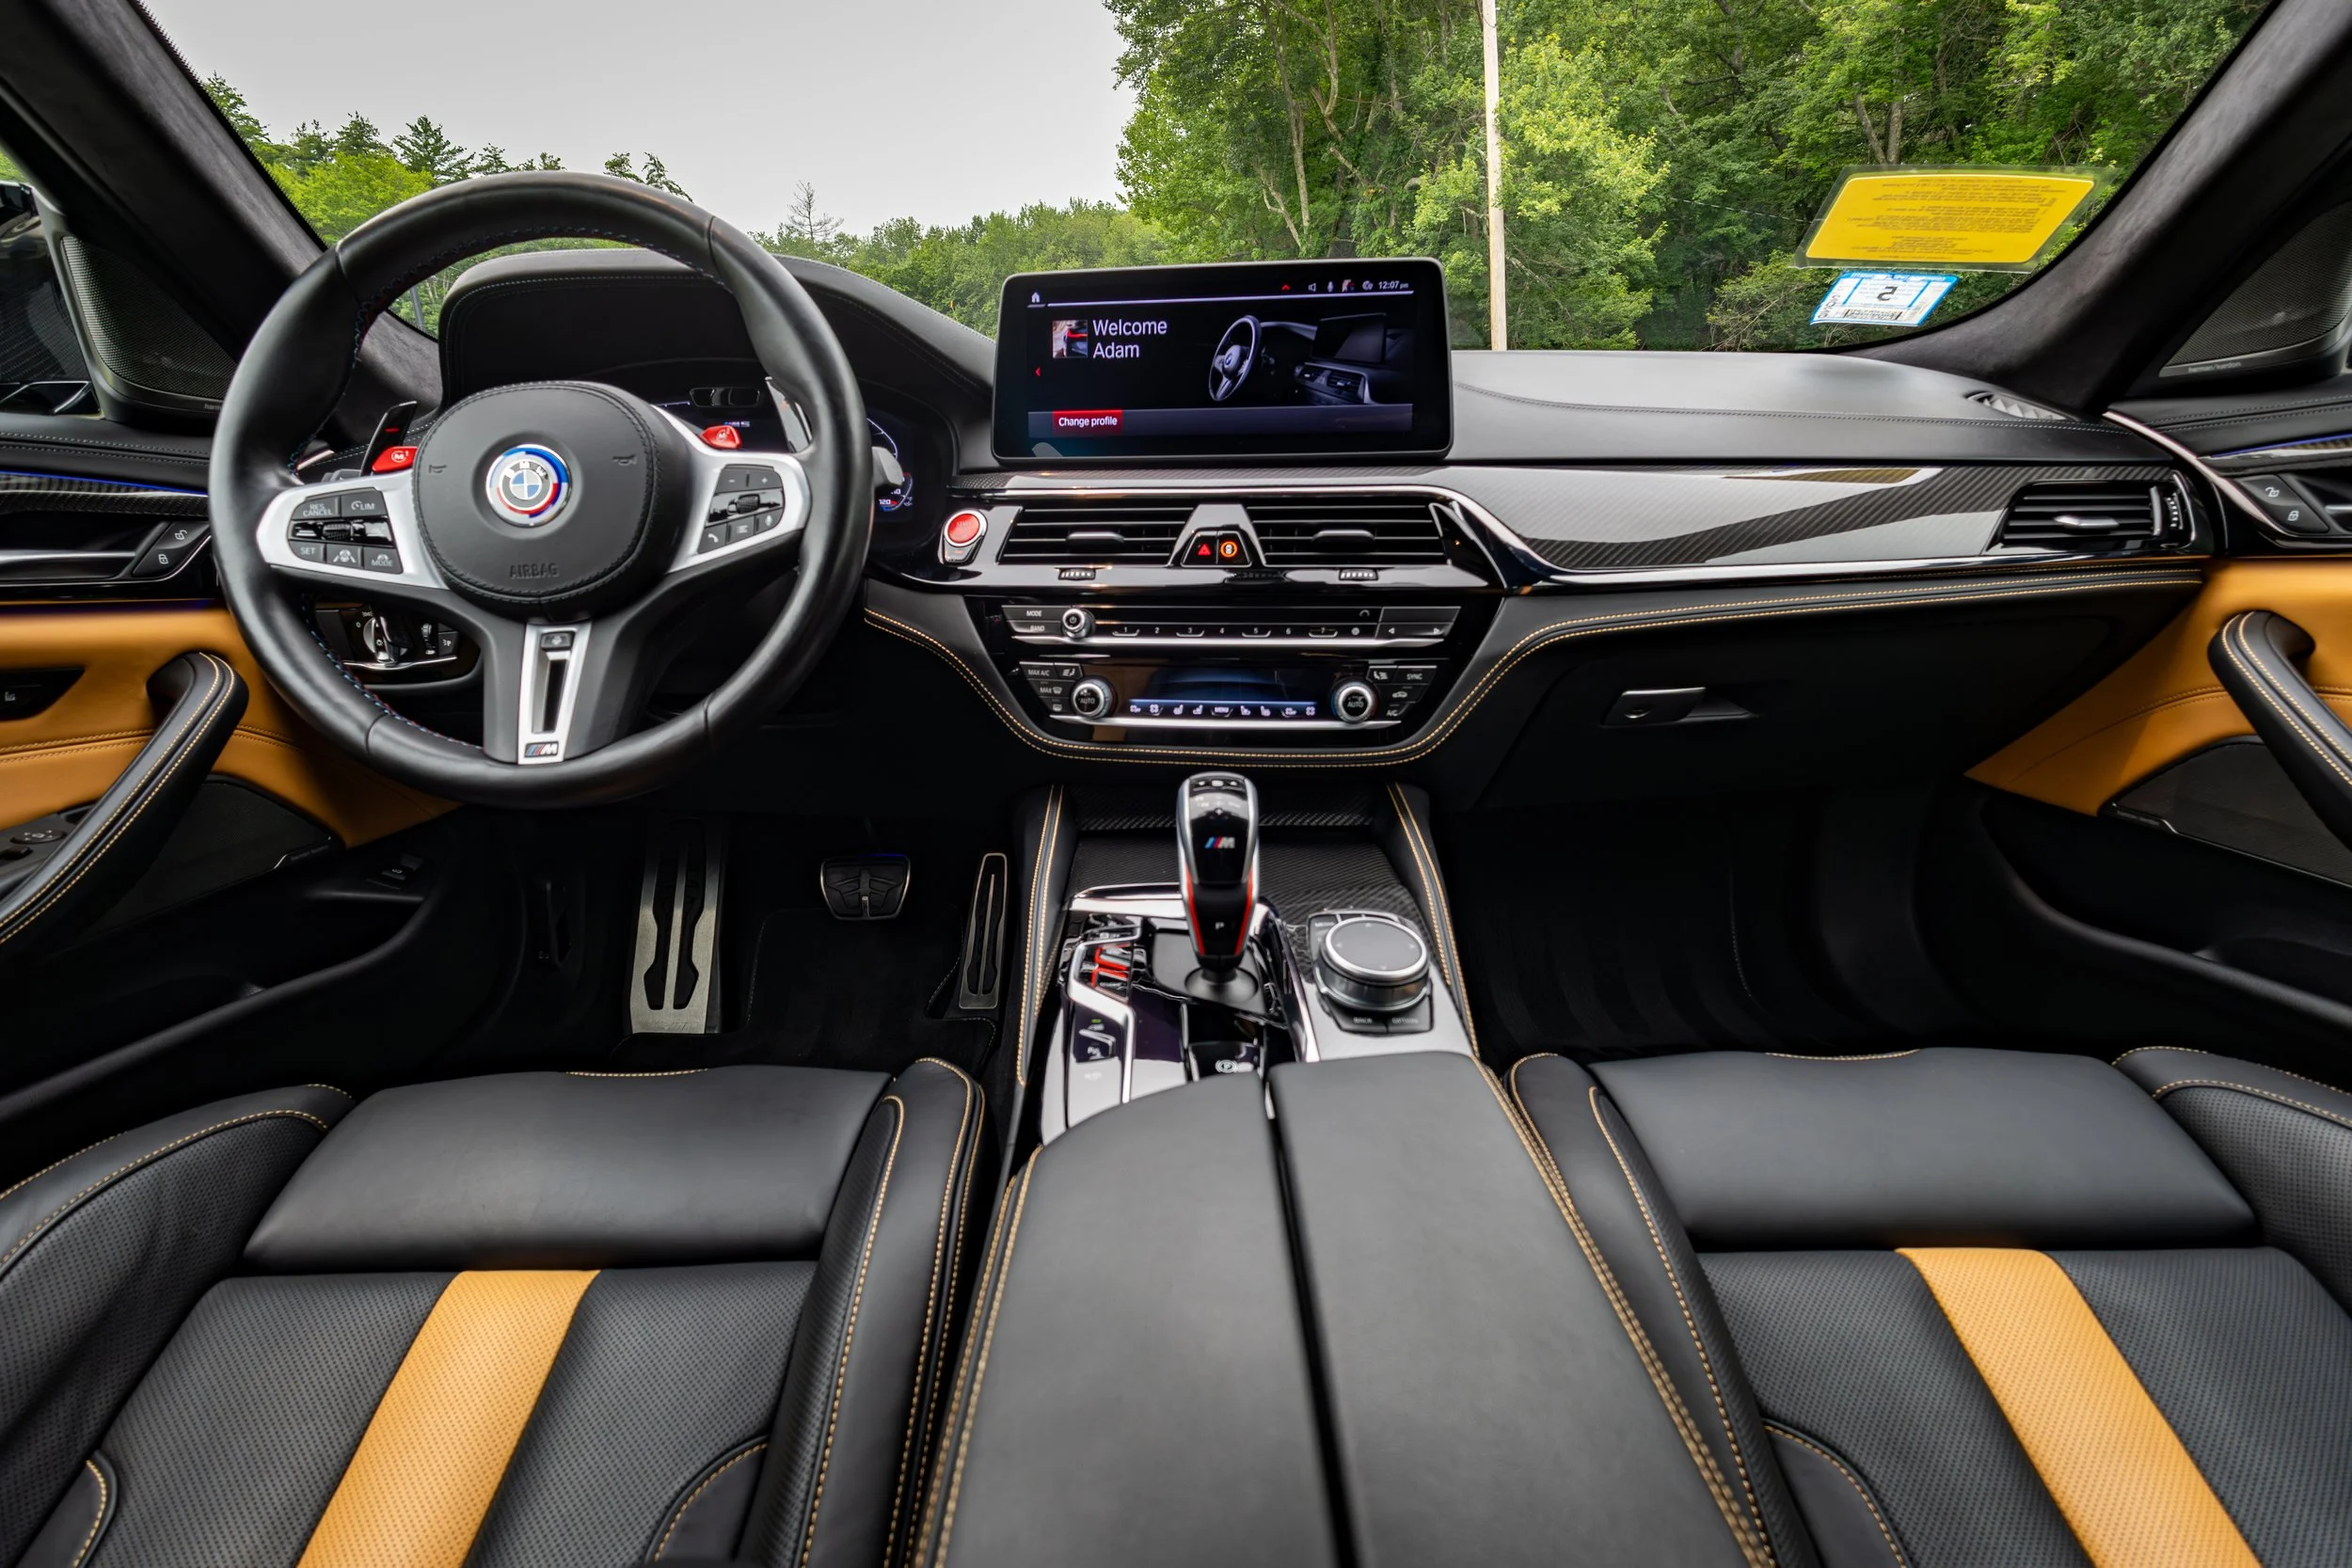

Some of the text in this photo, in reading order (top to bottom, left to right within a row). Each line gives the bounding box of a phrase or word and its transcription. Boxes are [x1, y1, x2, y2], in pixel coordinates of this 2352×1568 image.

[1378, 280, 1399, 290] 12:07
[1092, 319, 1168, 336] Welcome
[1092, 341, 1140, 358] Adam
[1058, 416, 1118, 428] Change profile
[360, 501, 375, 511] LIM
[300, 546, 316, 555] SET
[509, 563, 560, 579] AIRBAG
